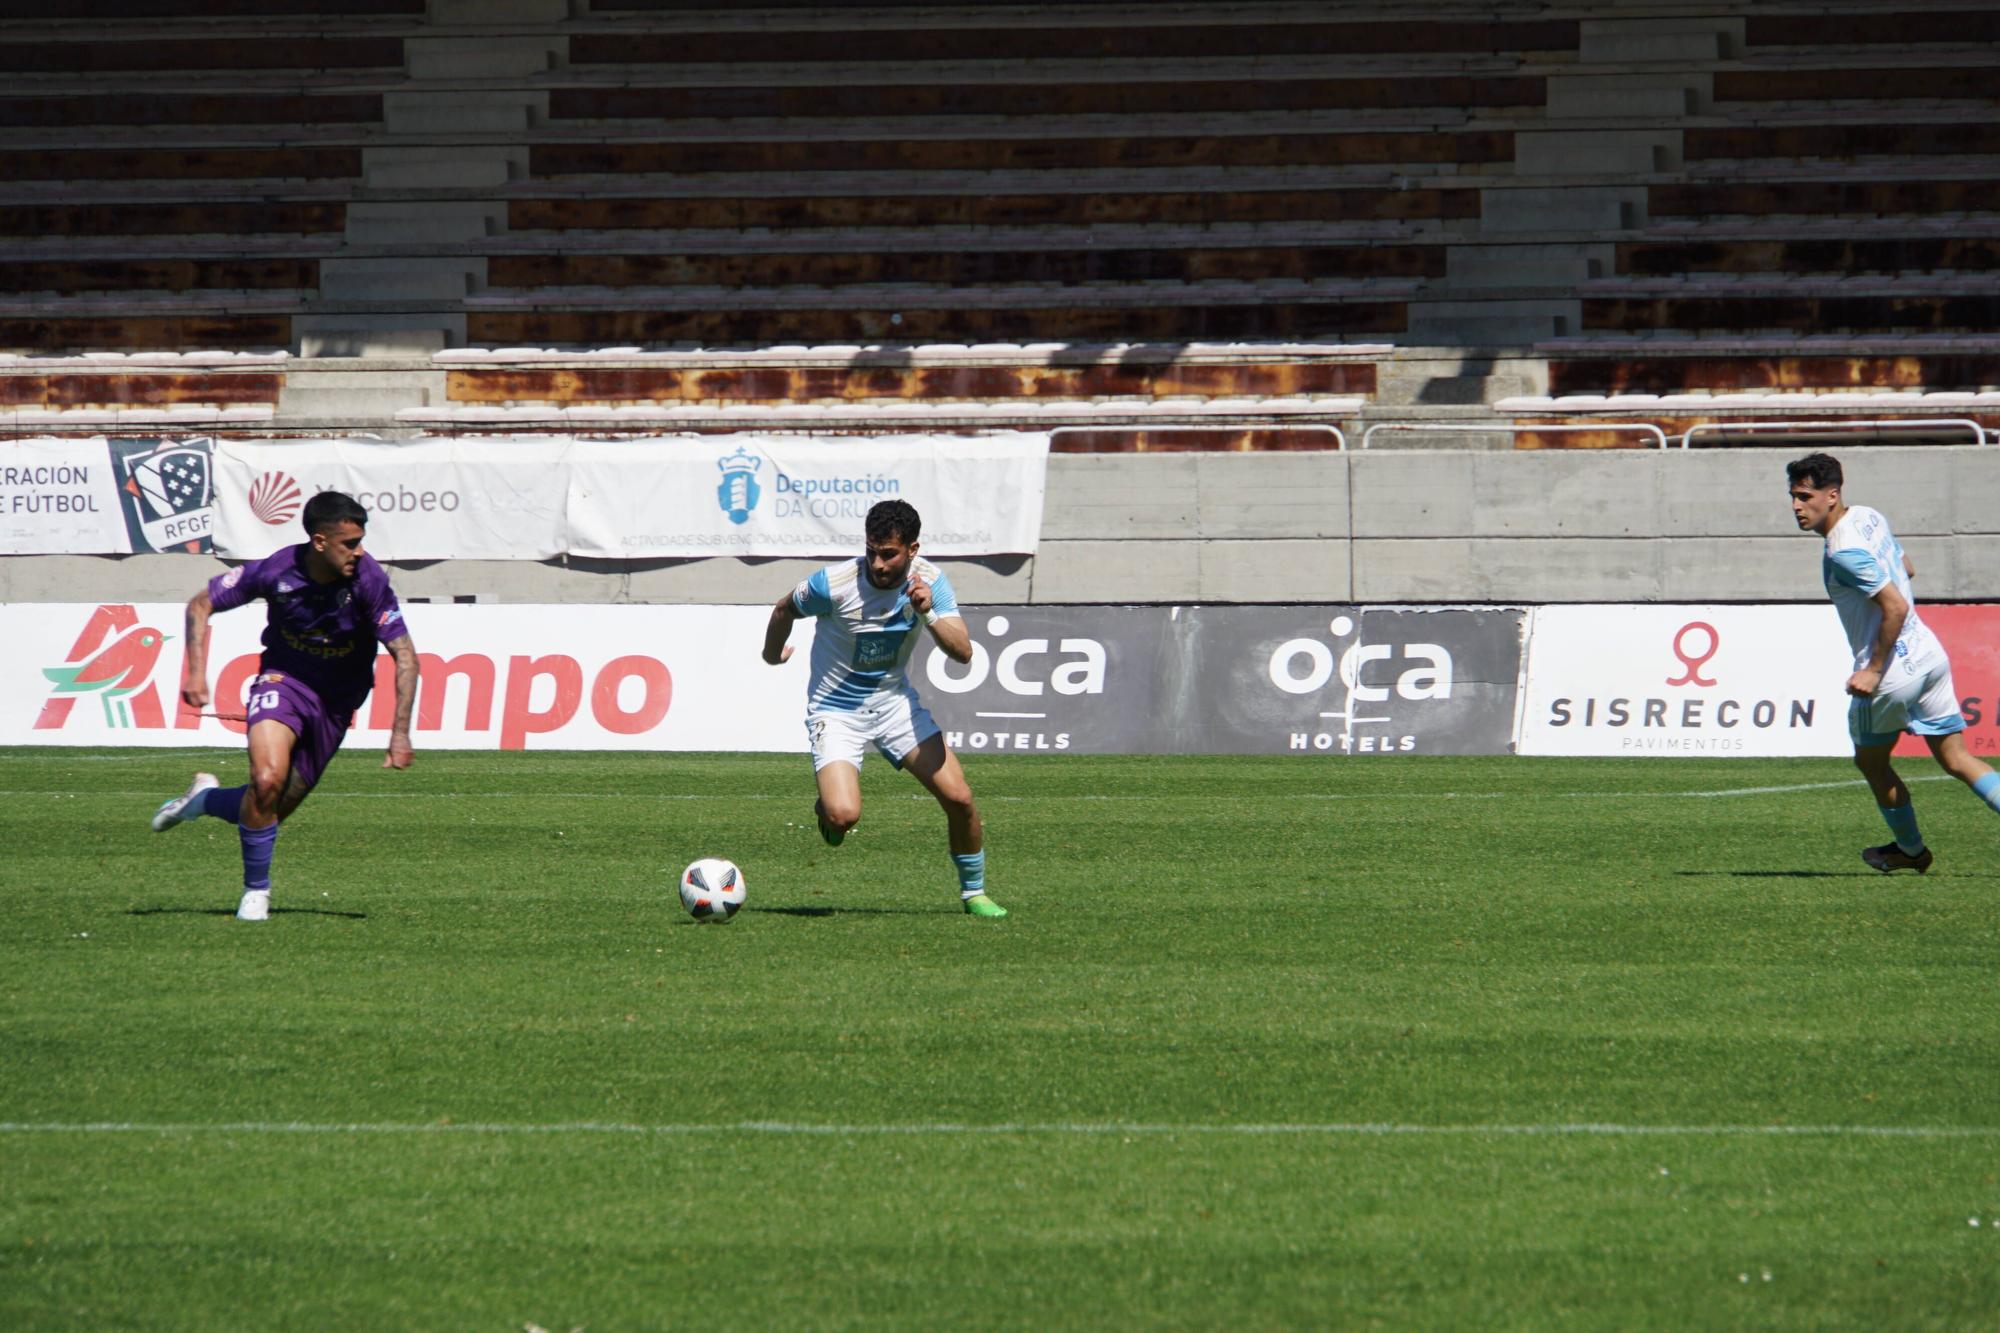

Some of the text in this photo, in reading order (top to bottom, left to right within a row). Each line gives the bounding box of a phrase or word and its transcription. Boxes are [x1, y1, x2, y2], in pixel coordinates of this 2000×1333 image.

[0, 461, 88, 485] RACIÓN
[776, 473, 899, 498] Deputación
[13, 489, 98, 512] FÚTBOL
[775, 496, 881, 518] DA CORU
[164, 514, 211, 539] RFGF
[926, 616, 1106, 696] oca
[1269, 616, 1453, 701] oca
[249, 690, 280, 717] 20
[1548, 697, 1815, 728] SISRECON
[945, 731, 1070, 749] HOTELS
[1290, 732, 1416, 751] HOTELS
[1622, 737, 1744, 750] PAVIMENTOS
